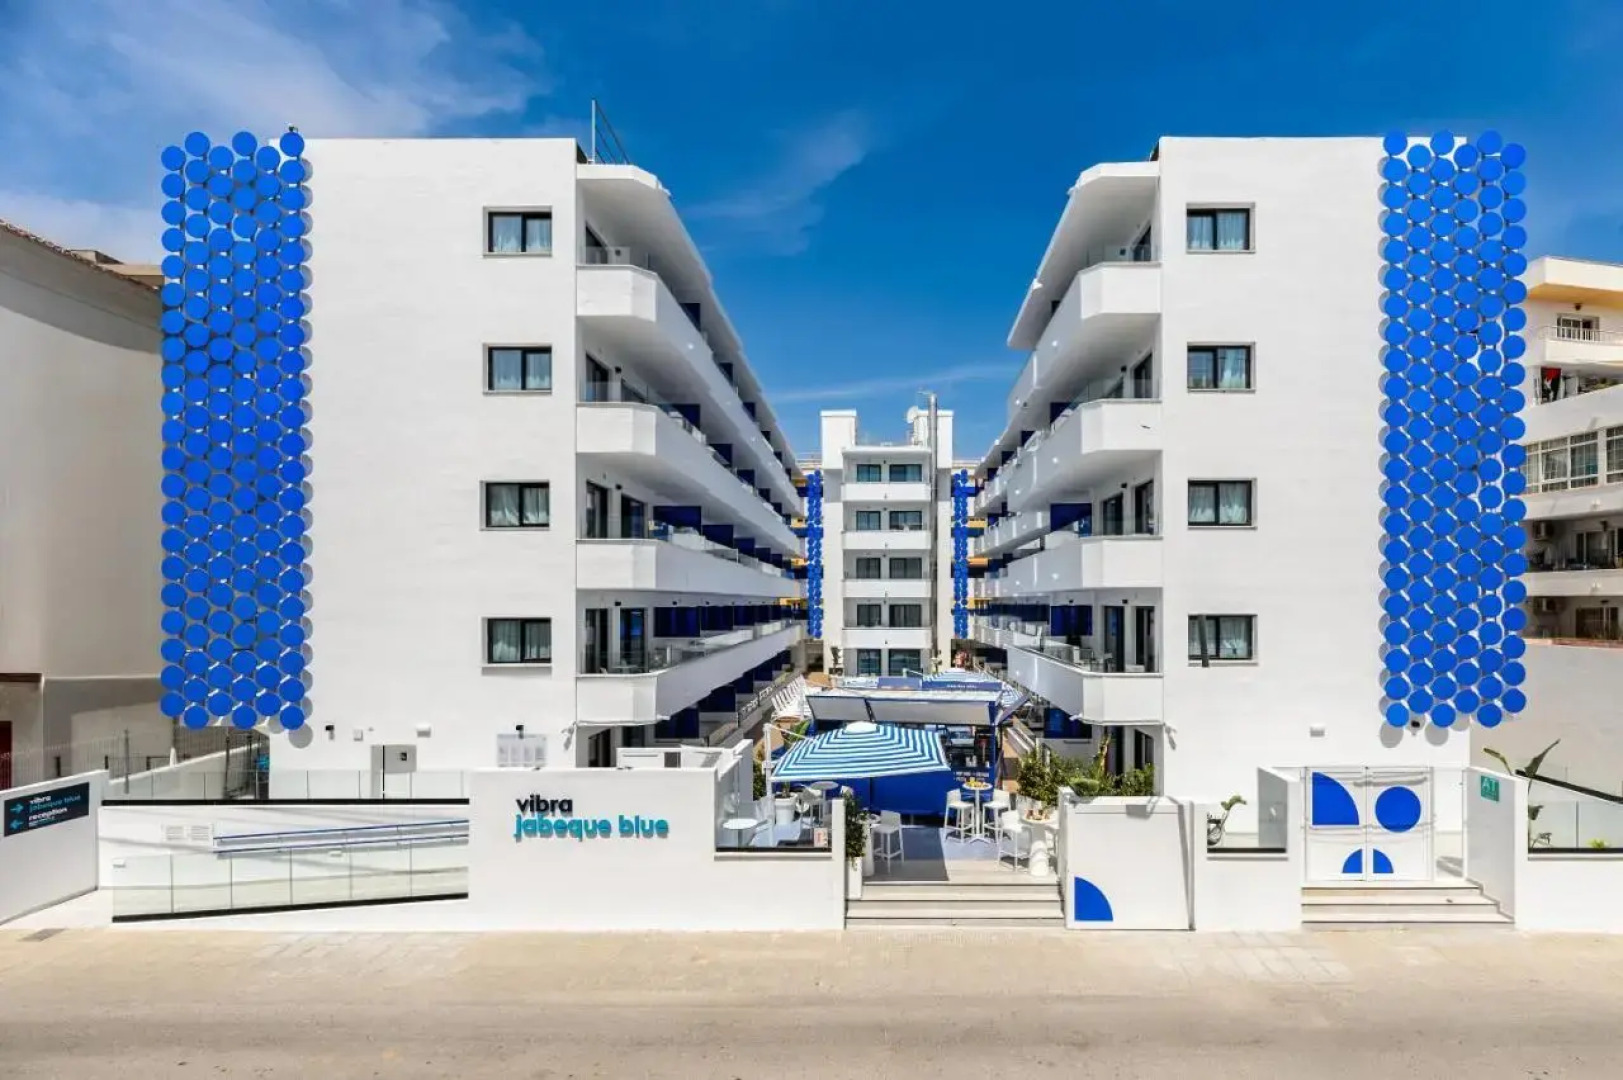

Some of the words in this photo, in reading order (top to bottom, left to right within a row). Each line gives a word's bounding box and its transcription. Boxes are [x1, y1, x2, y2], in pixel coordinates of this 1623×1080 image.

[1482, 777, 1497, 791] AT
[516, 794, 573, 814] vibra
[29, 807, 68, 820] reception
[514, 814, 612, 842] jabeque
[619, 815, 669, 838] blue
